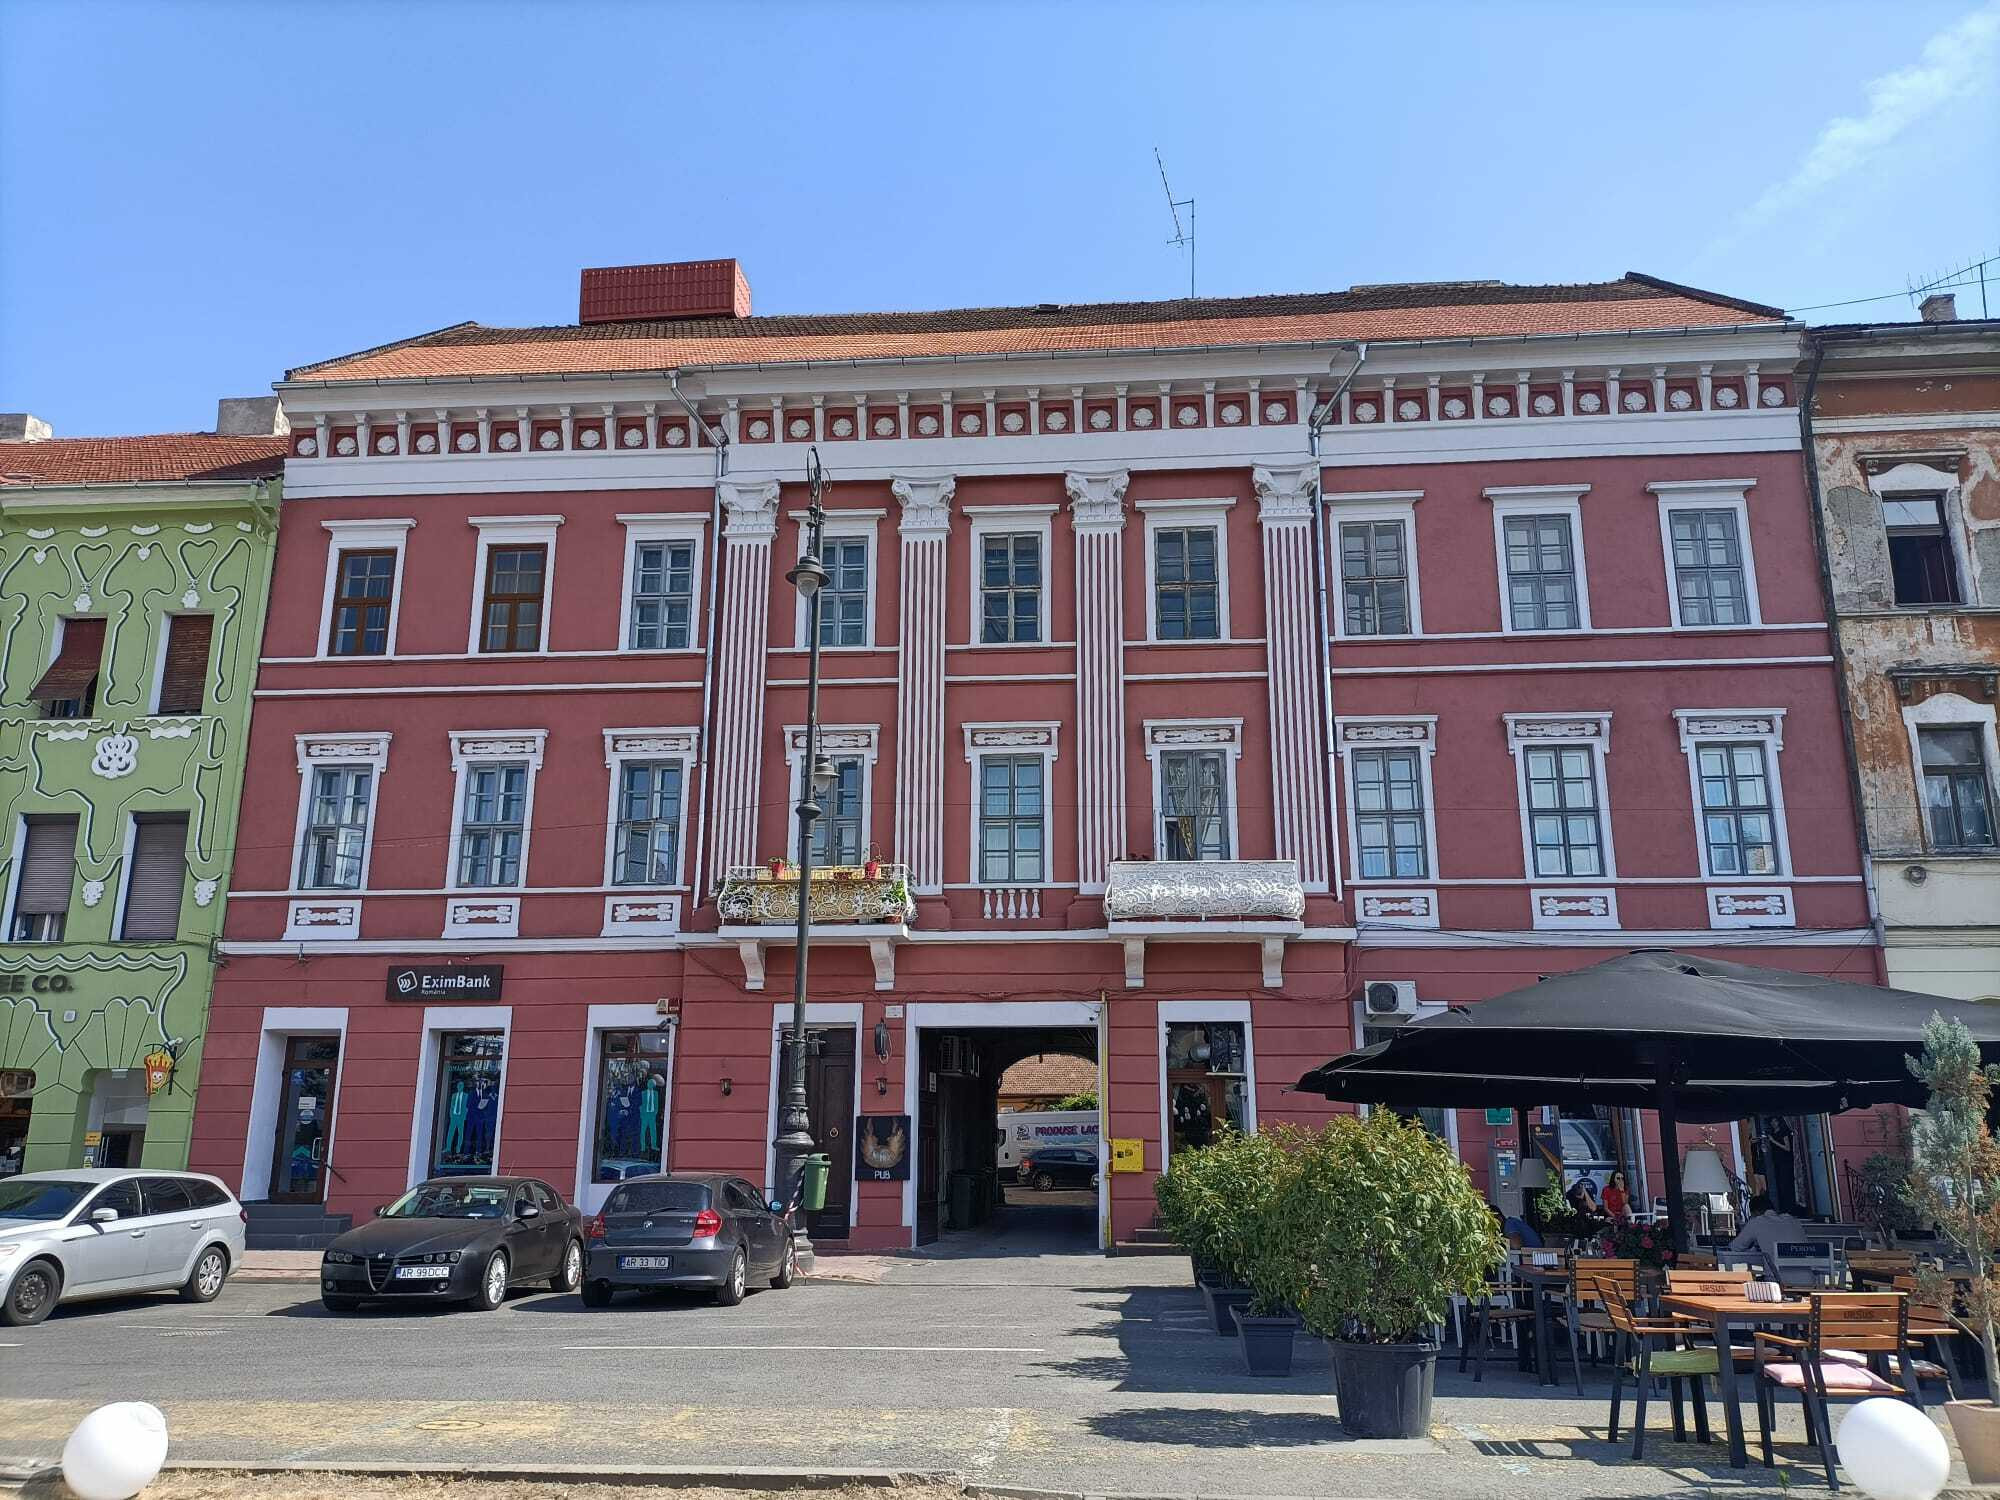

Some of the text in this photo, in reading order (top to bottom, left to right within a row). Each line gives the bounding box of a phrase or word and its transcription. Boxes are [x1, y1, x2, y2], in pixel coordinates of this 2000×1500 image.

[32, 974, 74, 993] CO.
[422, 975, 490, 988] EximBank
[1035, 1125, 1078, 1137] PRODUSE
[874, 1170, 891, 1180] PUB
[626, 1258, 637, 1267] AR
[639, 1258, 649, 1267] 33
[401, 1268, 414, 1278] AR
[1699, 1284, 1727, 1293] URSUS
[1843, 1310, 1874, 1320] URSUS
